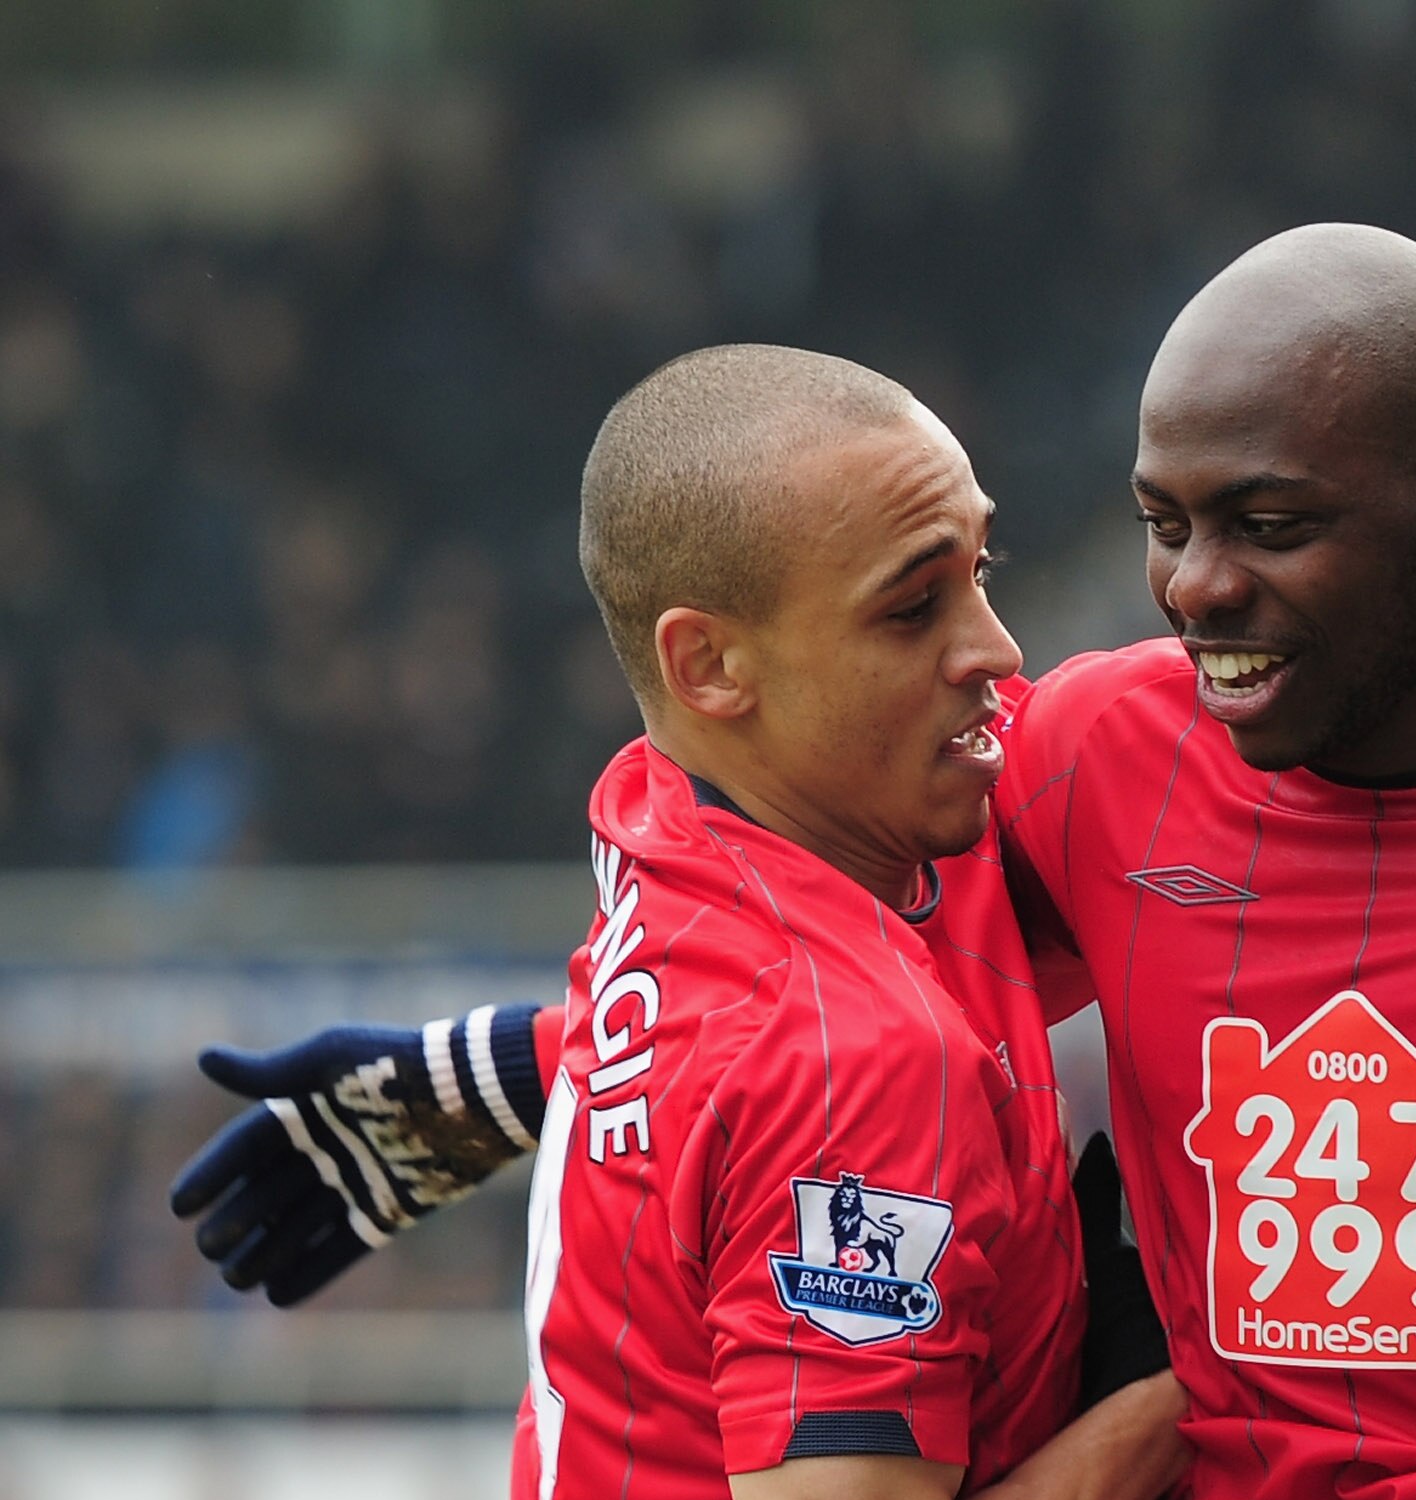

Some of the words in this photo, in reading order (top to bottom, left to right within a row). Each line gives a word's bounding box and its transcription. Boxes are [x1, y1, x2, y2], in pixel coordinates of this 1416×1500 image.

[1306, 1049, 1389, 1084] 0800
[794, 1289, 848, 1307] PREMIER
[849, 1298, 896, 1315] LEAGUE
[798, 1270, 900, 1303] BARCLAYS
